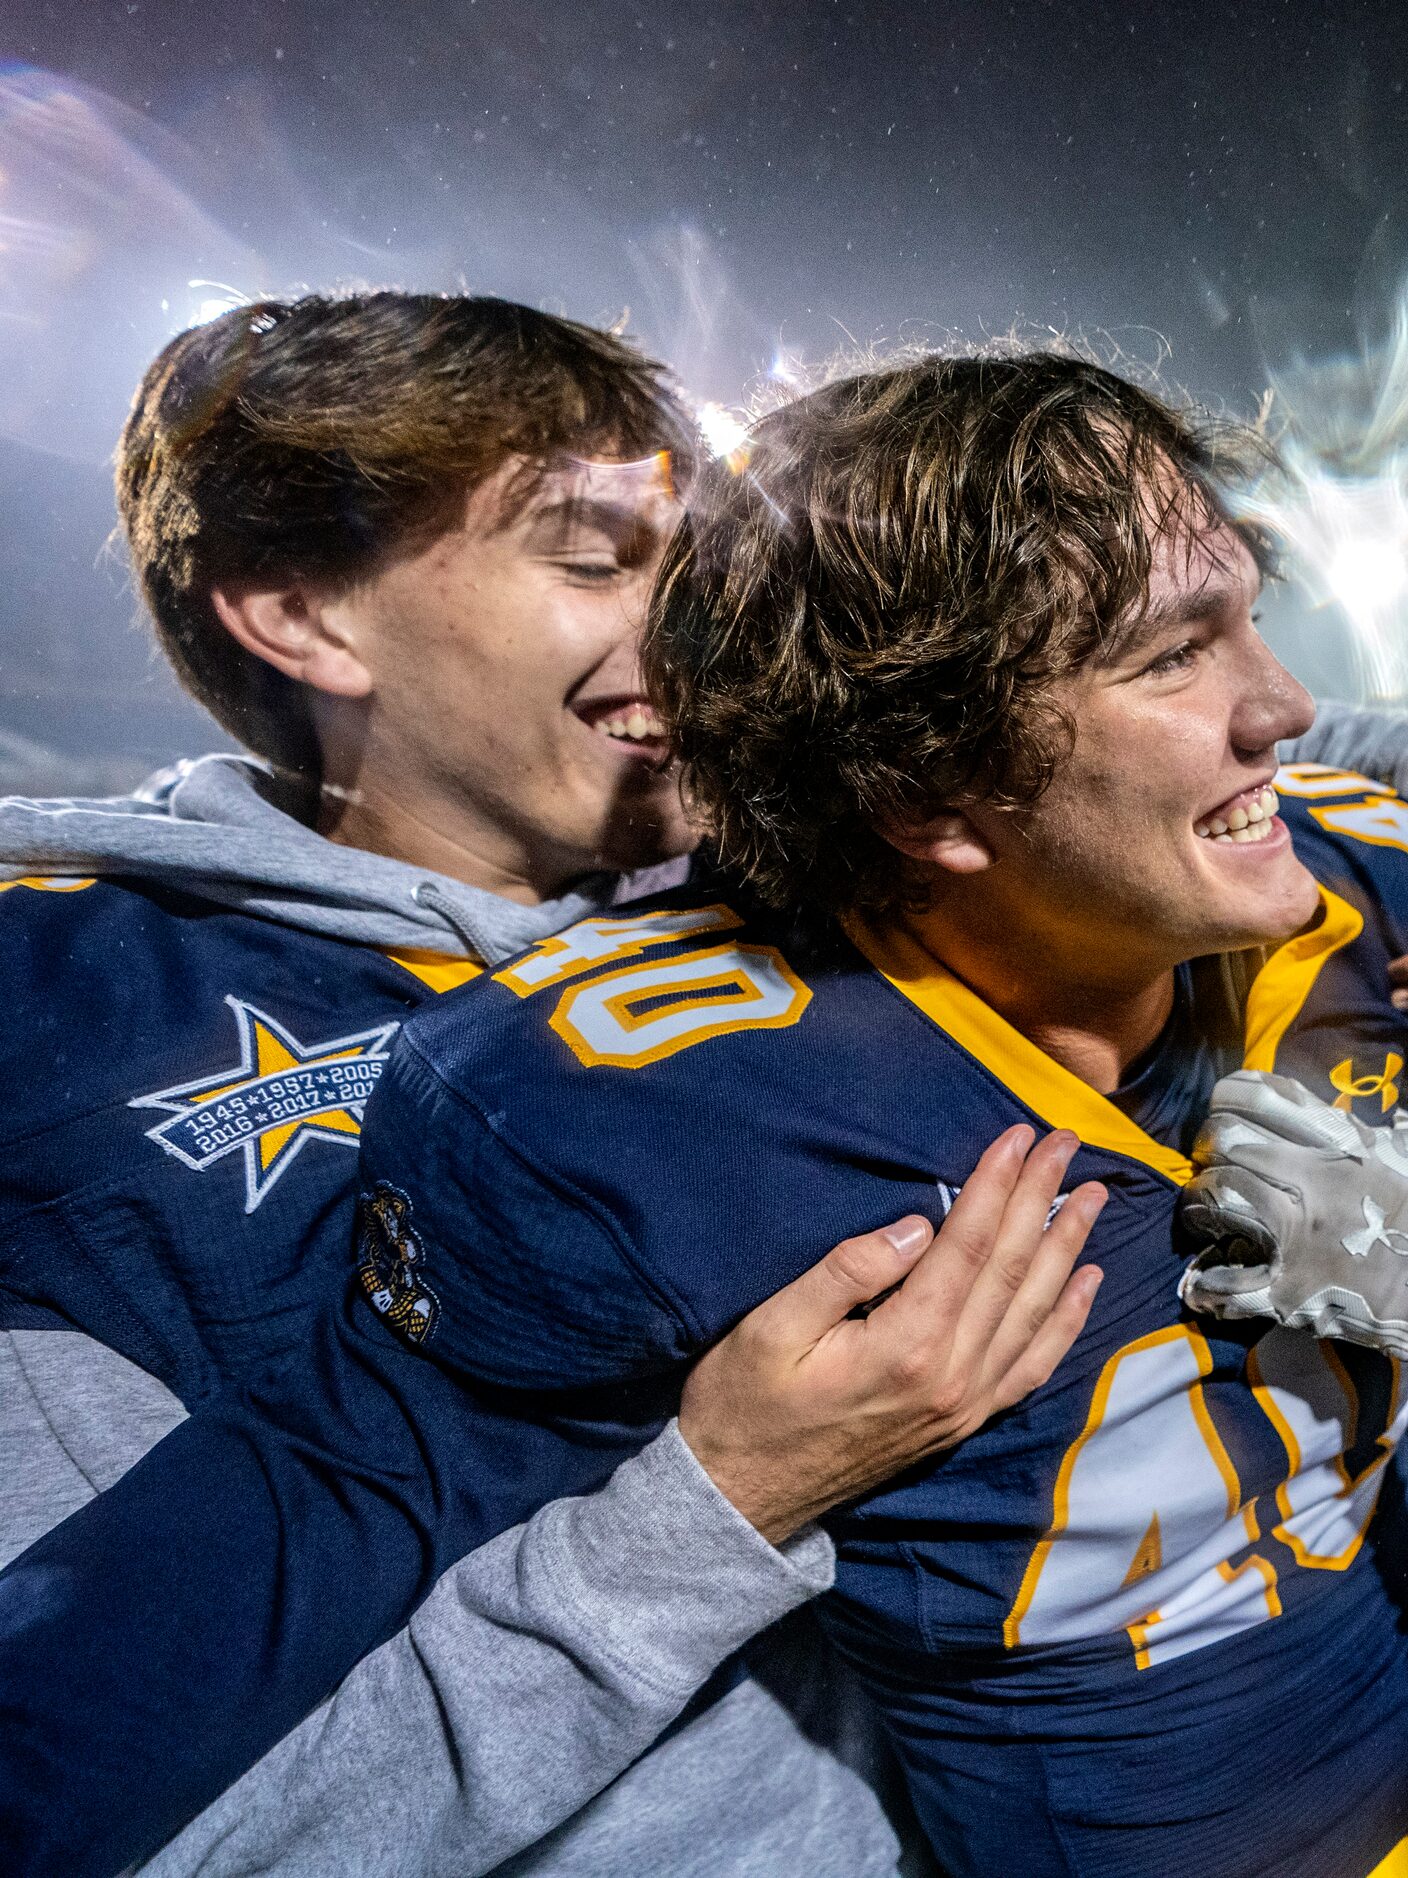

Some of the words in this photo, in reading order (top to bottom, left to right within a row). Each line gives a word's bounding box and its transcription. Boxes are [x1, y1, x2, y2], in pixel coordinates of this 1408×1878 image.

[491, 903, 814, 1070] 40
[185, 1097, 248, 1136] 1945
[259, 1072, 313, 1106] 1957
[329, 1062, 383, 1084] 2005
[196, 1116, 254, 1154] 2016
[268, 1090, 321, 1119] 2017
[340, 1080, 374, 1101] 201
